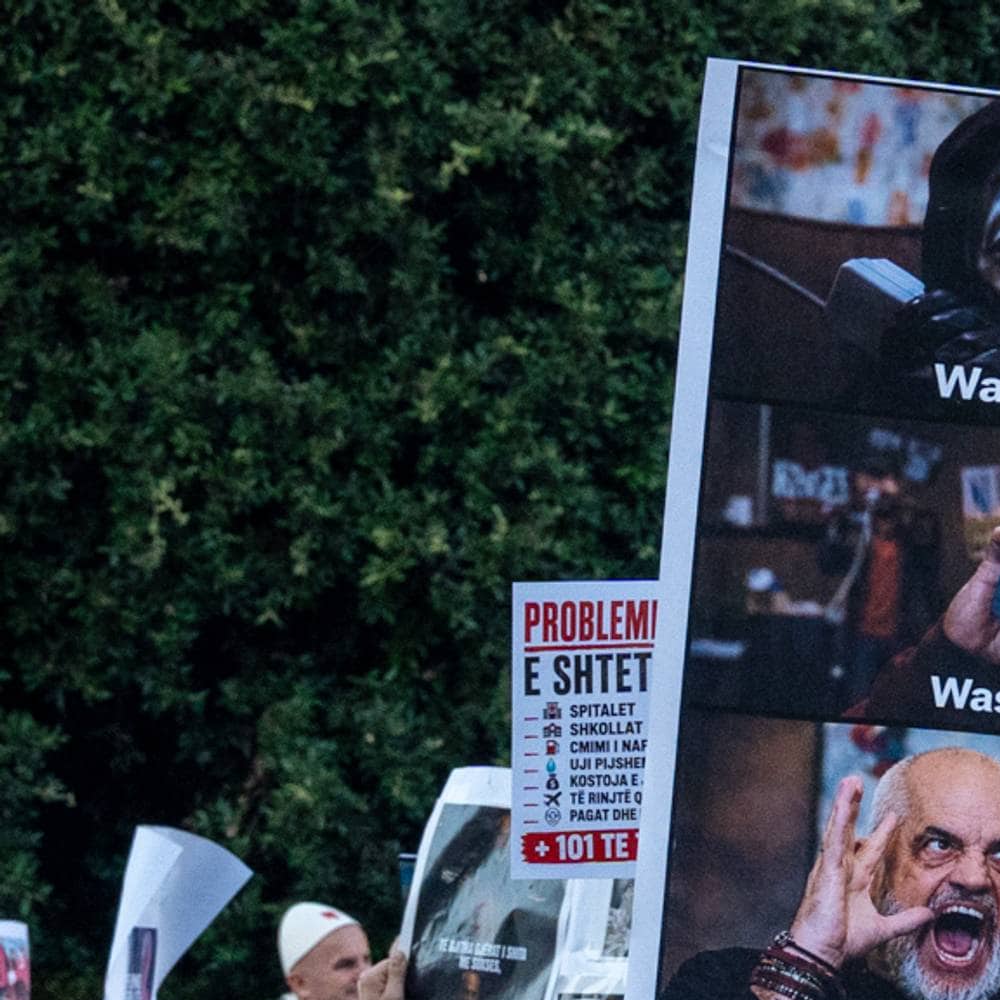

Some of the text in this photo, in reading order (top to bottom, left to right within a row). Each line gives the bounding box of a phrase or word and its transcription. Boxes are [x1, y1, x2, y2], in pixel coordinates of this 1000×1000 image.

[524, 599, 658, 642] PROBLEMI
[524, 652, 652, 696] E SHTET
[569, 703, 636, 718] SPITALET
[569, 721, 643, 736] SHKOLLAT
[569, 740, 610, 753] CMIMI
[614, 740, 618, 753] I
[569, 758, 592, 771] UJI
[569, 773, 639, 787] KOSTOJA E
[569, 789, 585, 804] TË
[588, 789, 632, 804] RINJTË
[569, 808, 637, 822] PAGAT DHE
[555, 833, 594, 860] 101
[600, 832, 629, 859] TE
